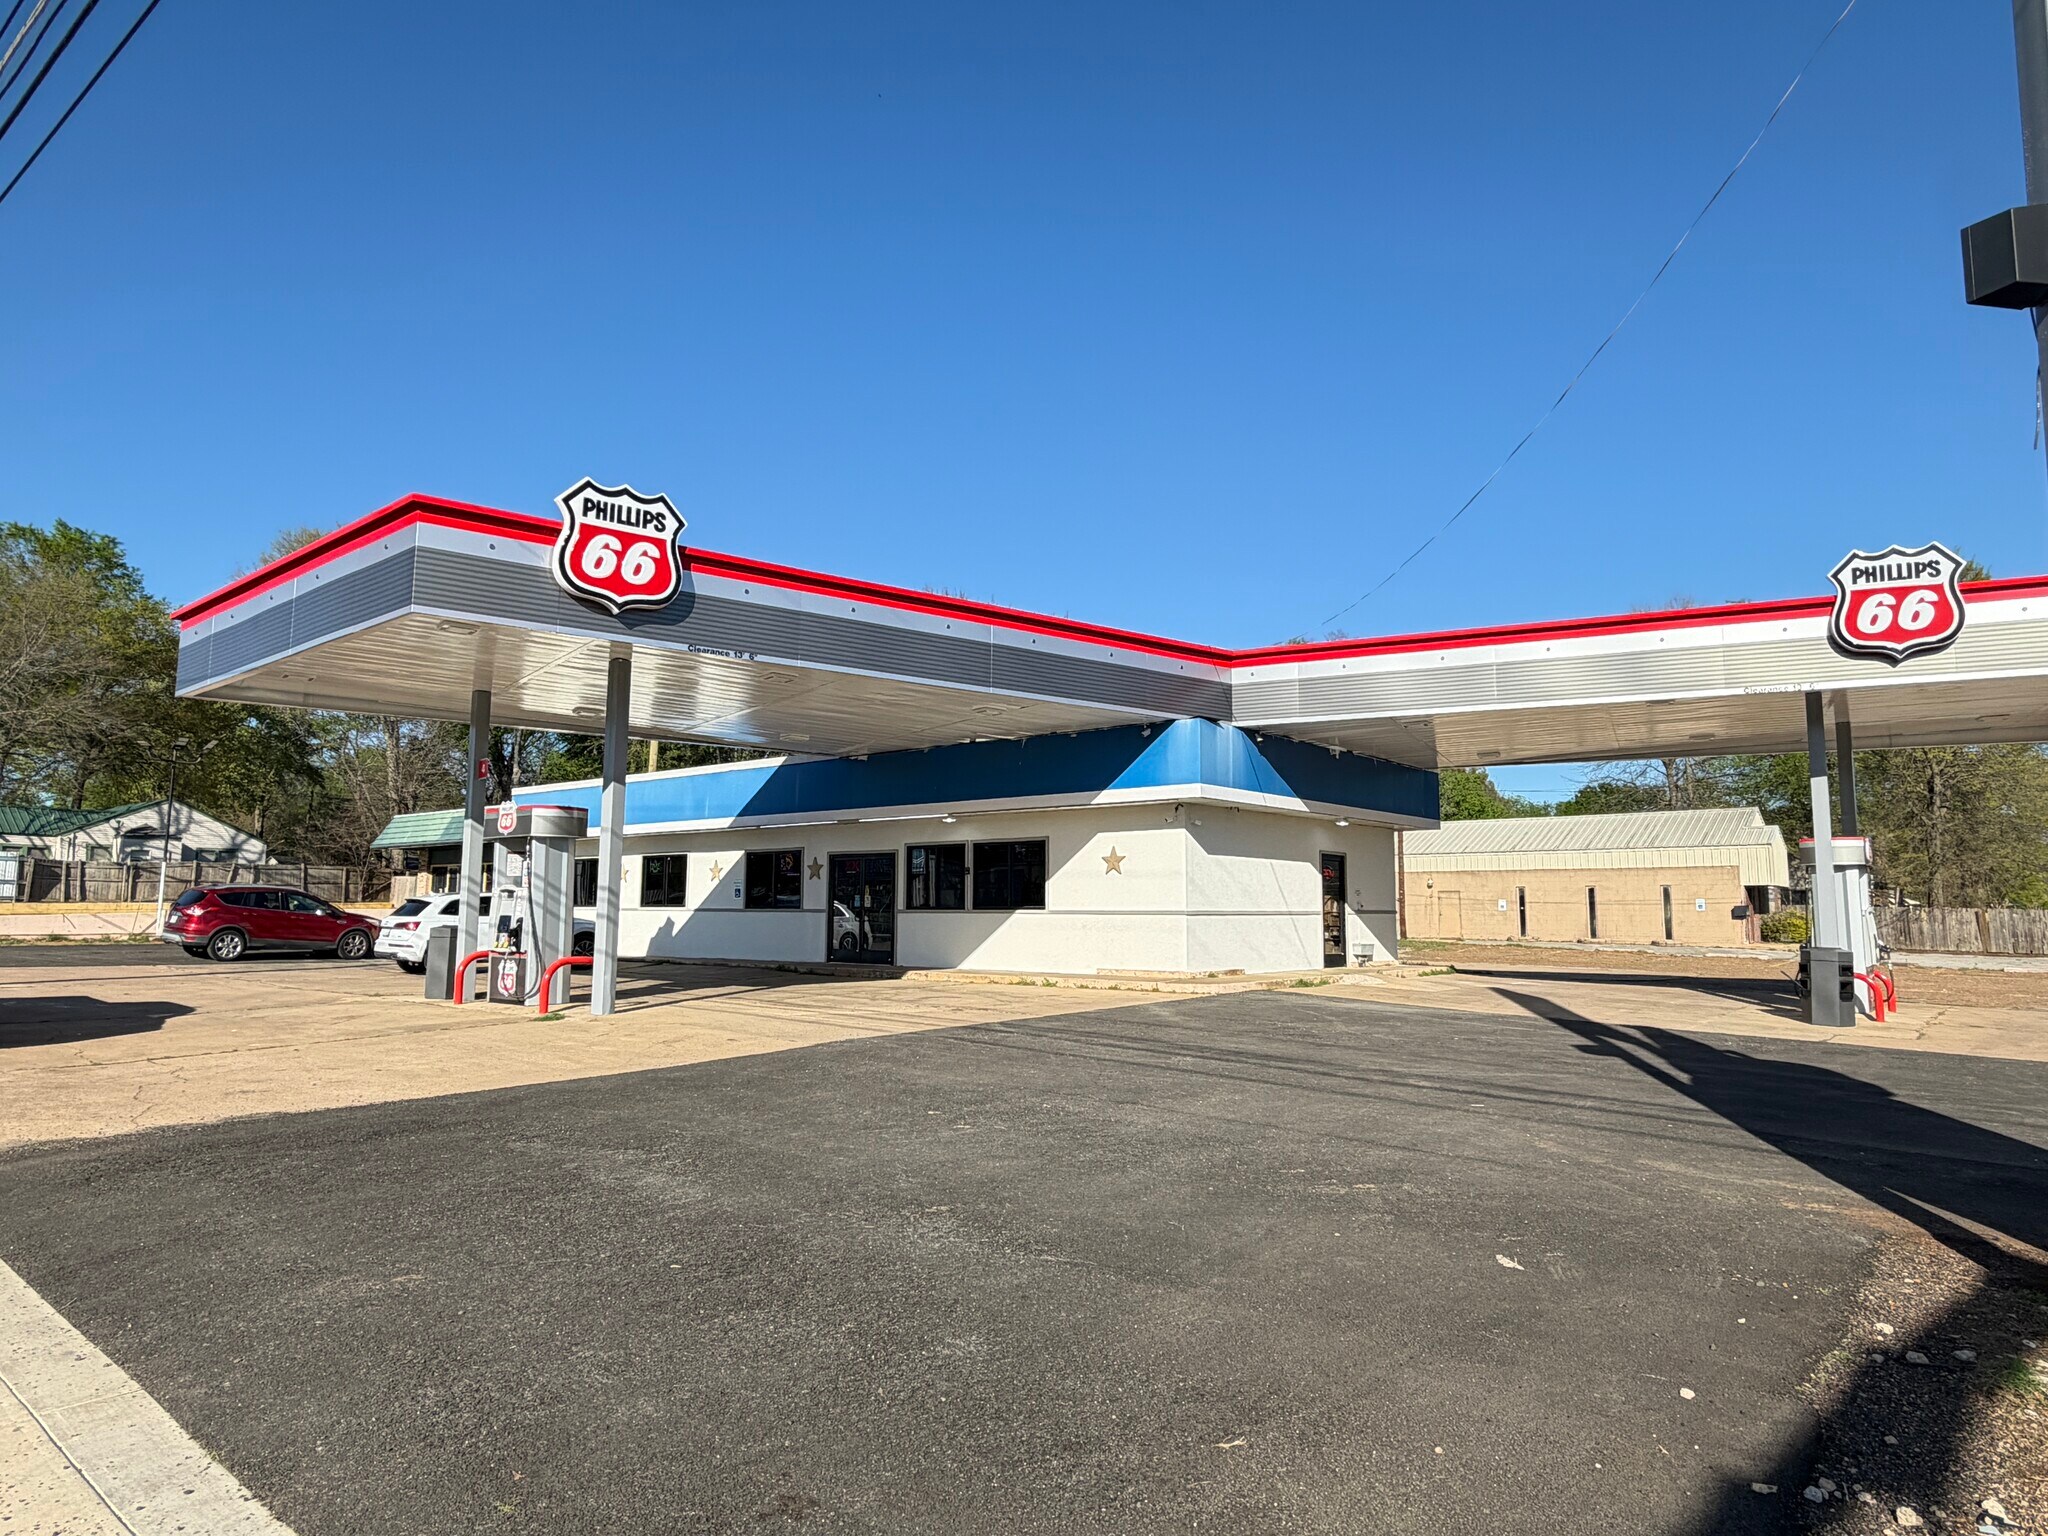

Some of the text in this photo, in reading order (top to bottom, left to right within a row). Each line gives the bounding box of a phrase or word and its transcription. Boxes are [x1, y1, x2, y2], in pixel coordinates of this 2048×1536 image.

[582, 497, 667, 533] PHILLIPS
[581, 533, 661, 586] 66
[1851, 559, 1942, 585] PHILLIPS
[1856, 589, 1939, 634] 66
[687, 644, 731, 657] Clearance
[1743, 686, 1789, 695] Clearance
[501, 814, 513, 828] 66
